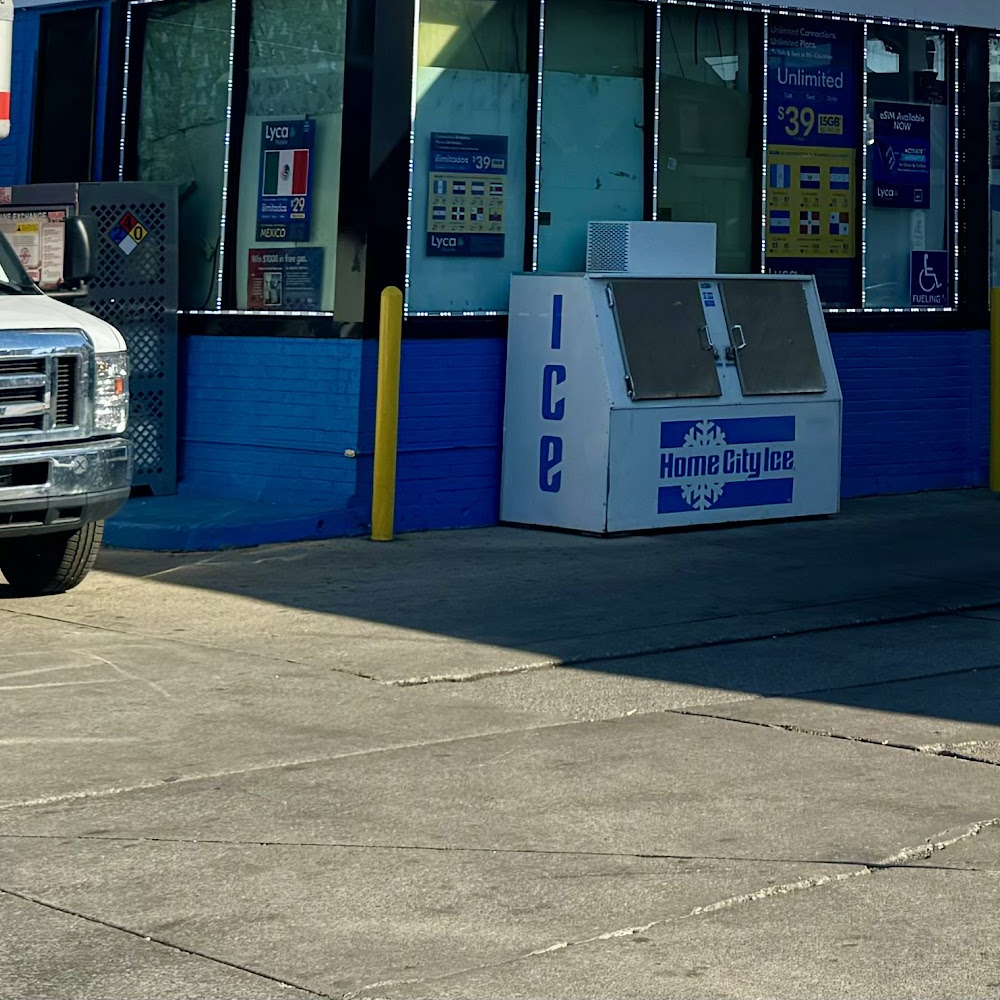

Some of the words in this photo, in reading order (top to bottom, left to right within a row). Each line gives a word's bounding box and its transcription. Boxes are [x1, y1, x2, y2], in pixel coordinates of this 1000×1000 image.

[770, 26, 799, 36] Unlimited
[770, 37, 799, 47] Unlimited
[778, 67, 844, 89] Unlimited
[778, 105, 816, 137] $39
[880, 110, 896, 121] eSIM
[897, 112, 925, 123] Available
[265, 125, 290, 141] Lyca
[893, 121, 912, 131] NOW
[472, 156, 491, 170] $39
[877, 186, 895, 199] Lyca
[290, 197, 306, 213] $29
[134, 224, 143, 240] 0
[259, 228, 287, 239] MEXICO
[431, 235, 457, 249] Lyca
[912, 294, 941, 304] FUELING
[540, 294, 566, 493] Ice
[660, 453, 720, 479] Home
[723, 448, 762, 479] City
[763, 447, 793, 472] Ice
